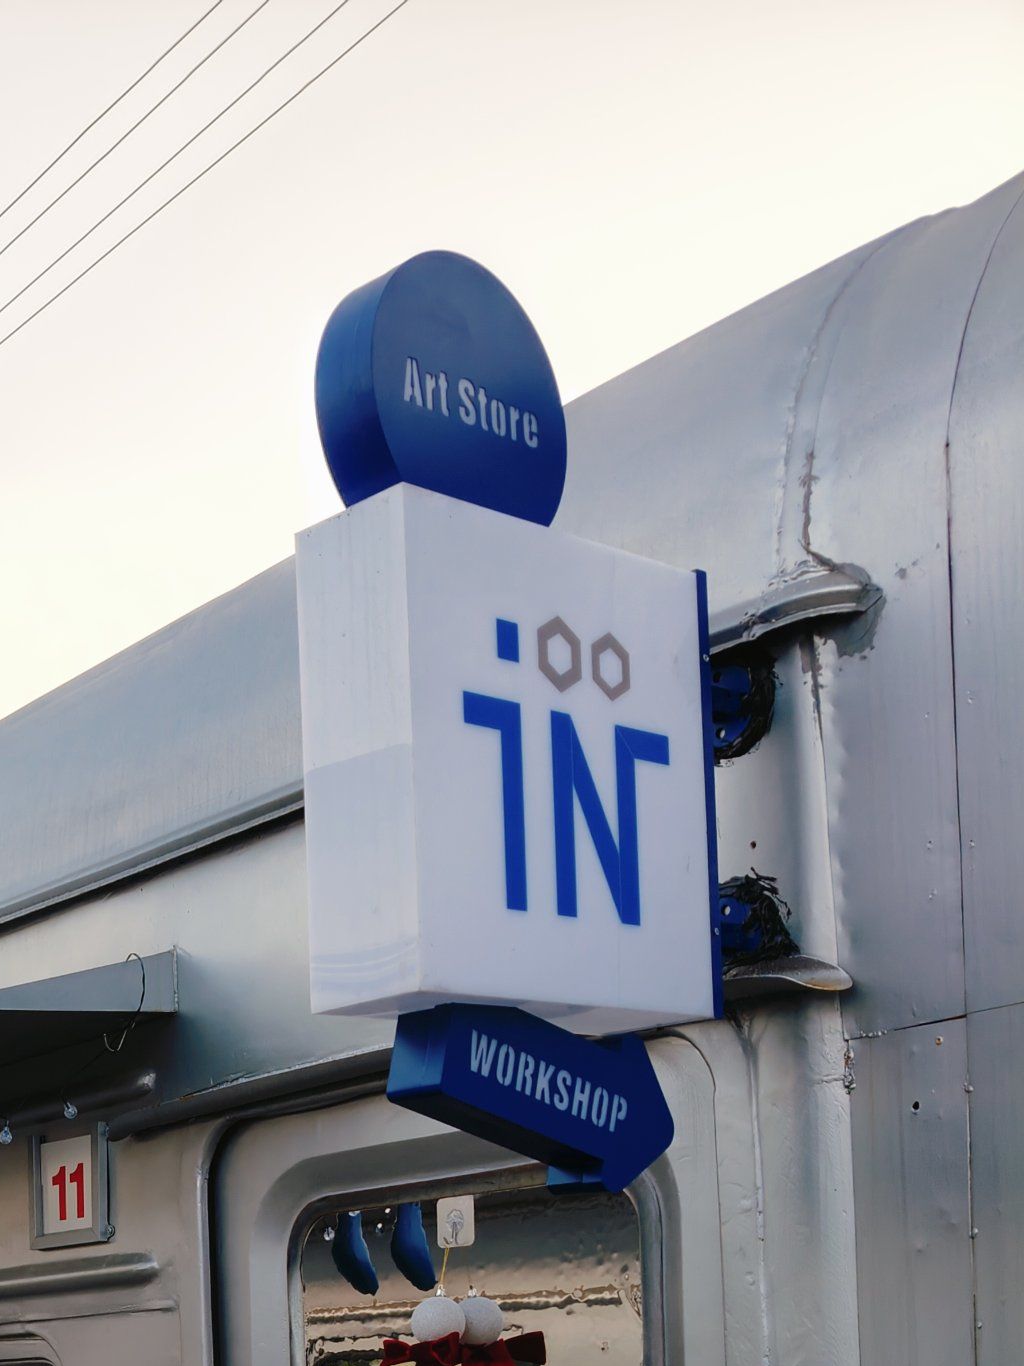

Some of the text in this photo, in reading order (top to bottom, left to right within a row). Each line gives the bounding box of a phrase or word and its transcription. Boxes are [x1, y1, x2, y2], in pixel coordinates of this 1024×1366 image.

[403, 356, 539, 449] Art Store
[469, 1029, 628, 1133] WORKSHOP
[51, 1162, 85, 1221] 11
